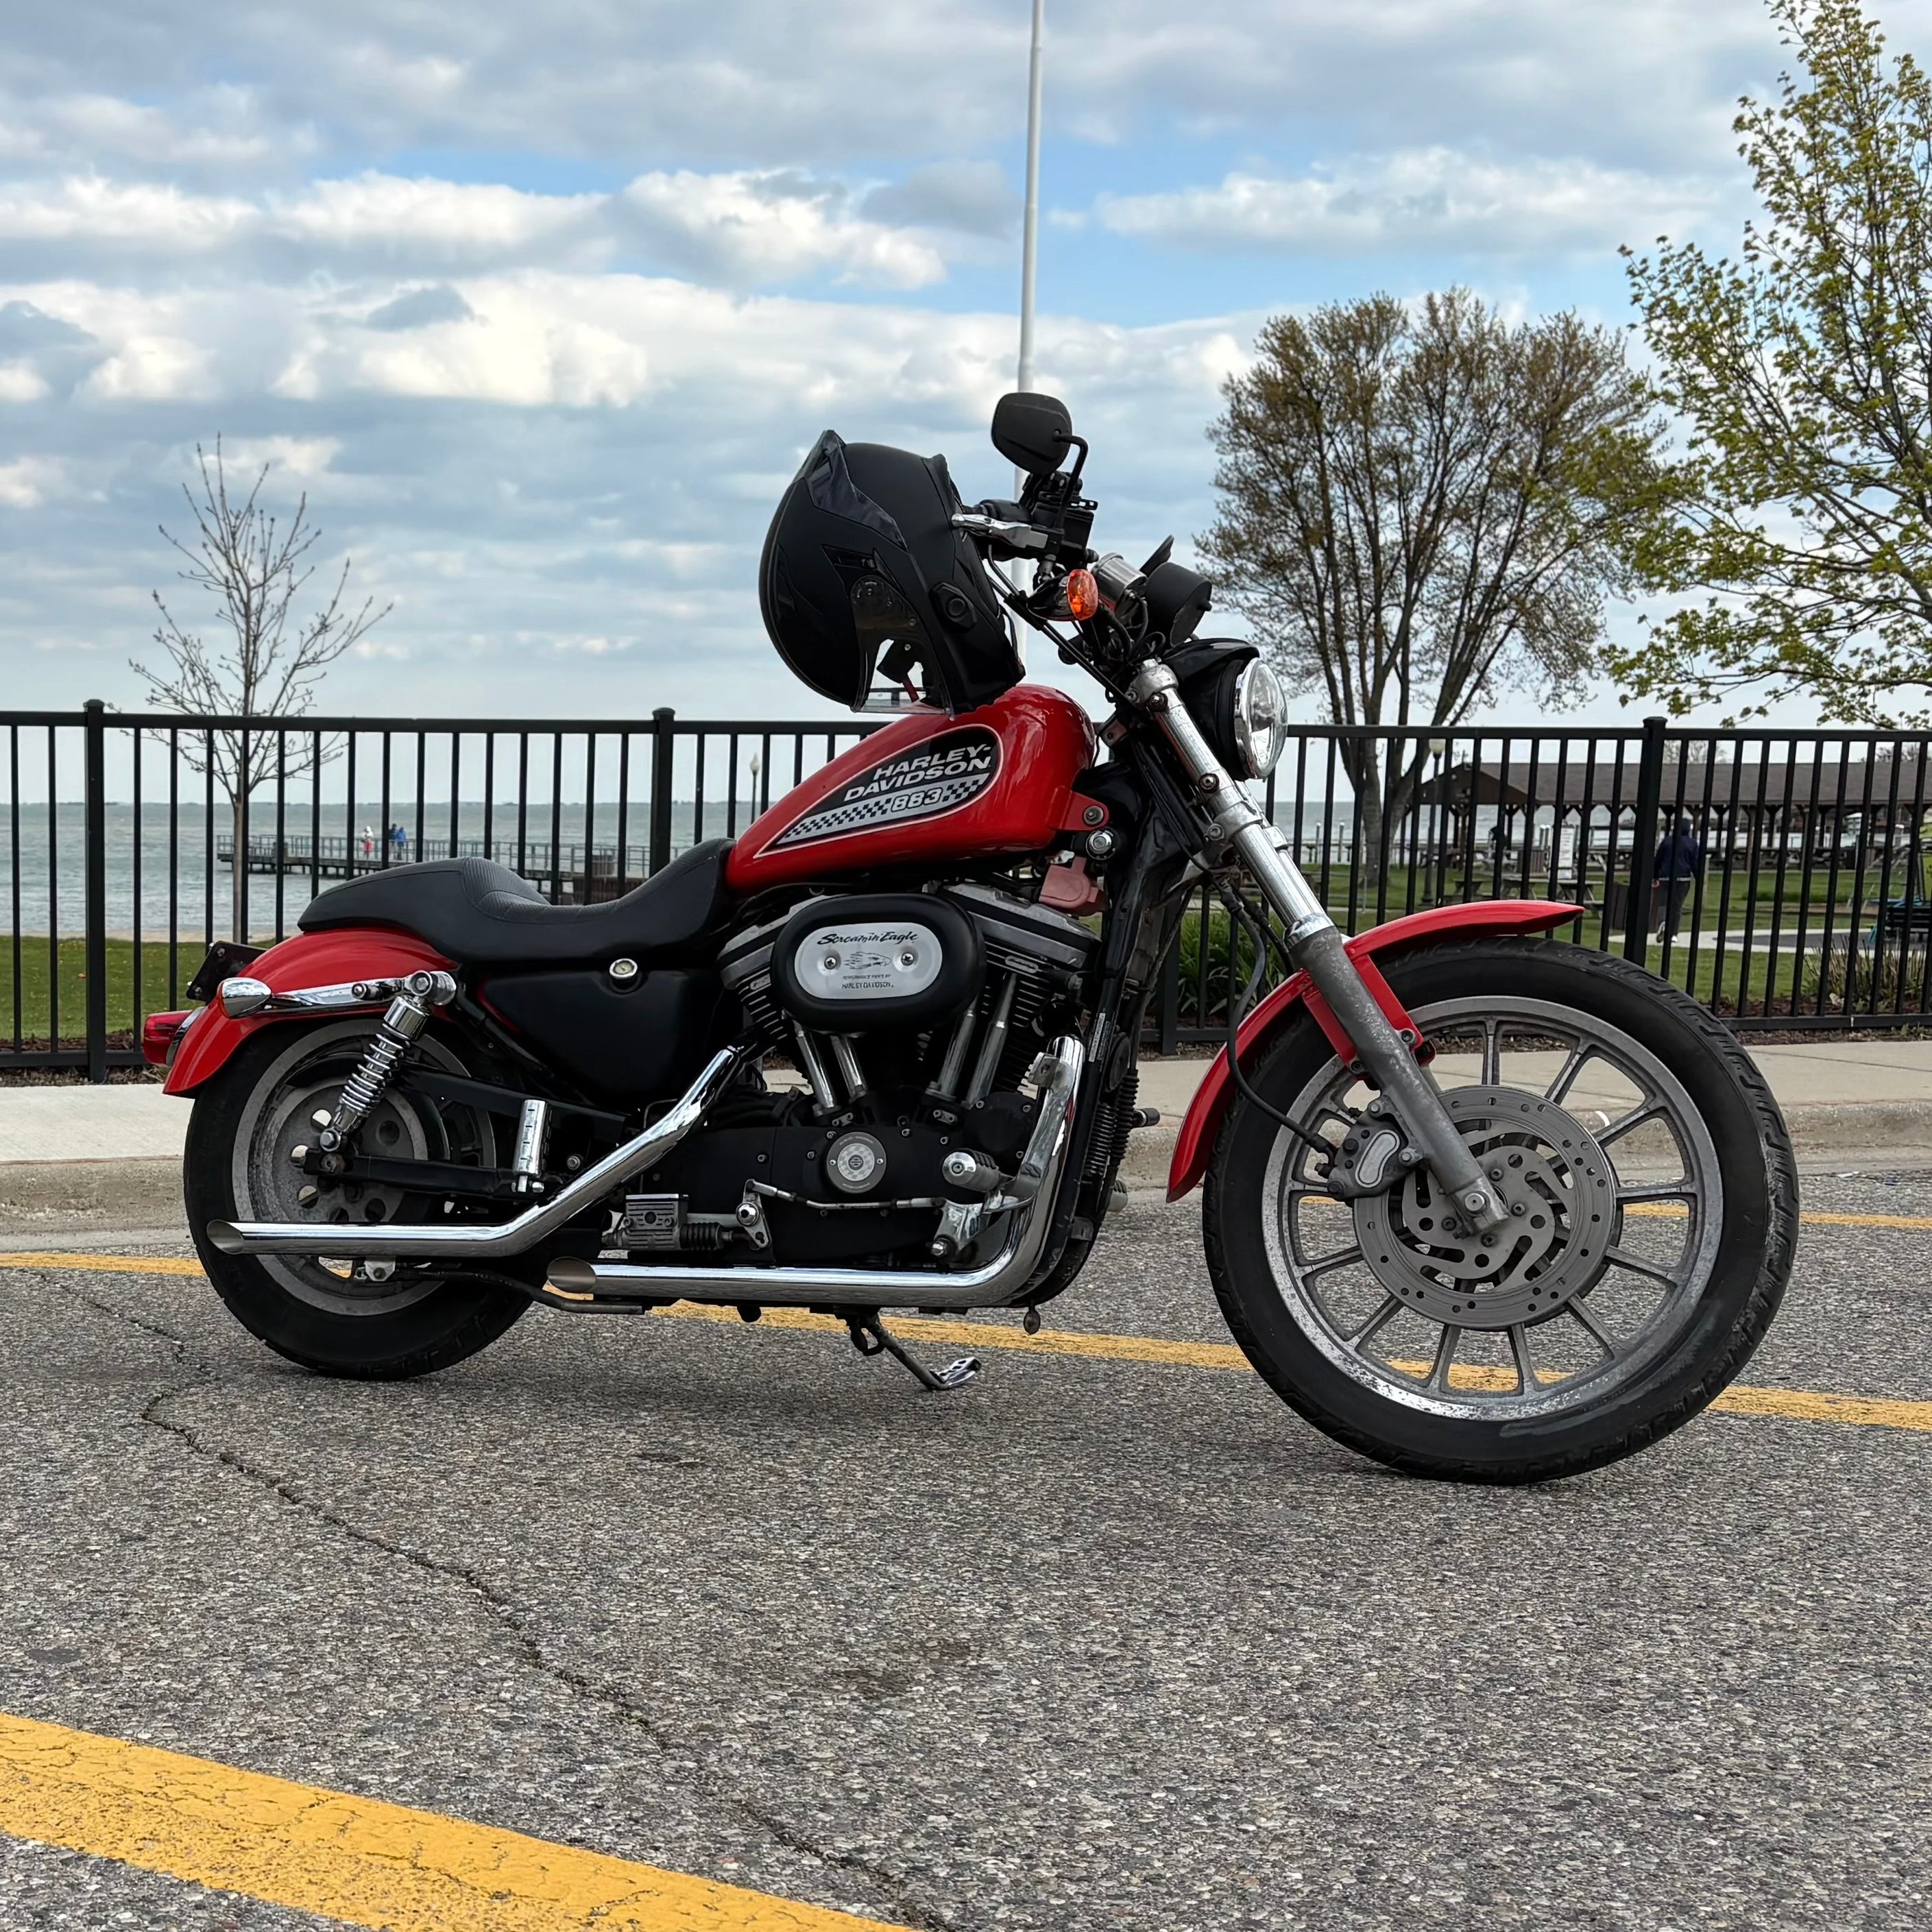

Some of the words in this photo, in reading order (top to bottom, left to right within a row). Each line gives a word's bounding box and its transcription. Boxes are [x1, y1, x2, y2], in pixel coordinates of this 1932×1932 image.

[873, 744, 991, 780] HARLEY-
[844, 756, 991, 801] DAVIDSON
[892, 788, 943, 812] 883
[880, 931, 919, 945] Eagle
